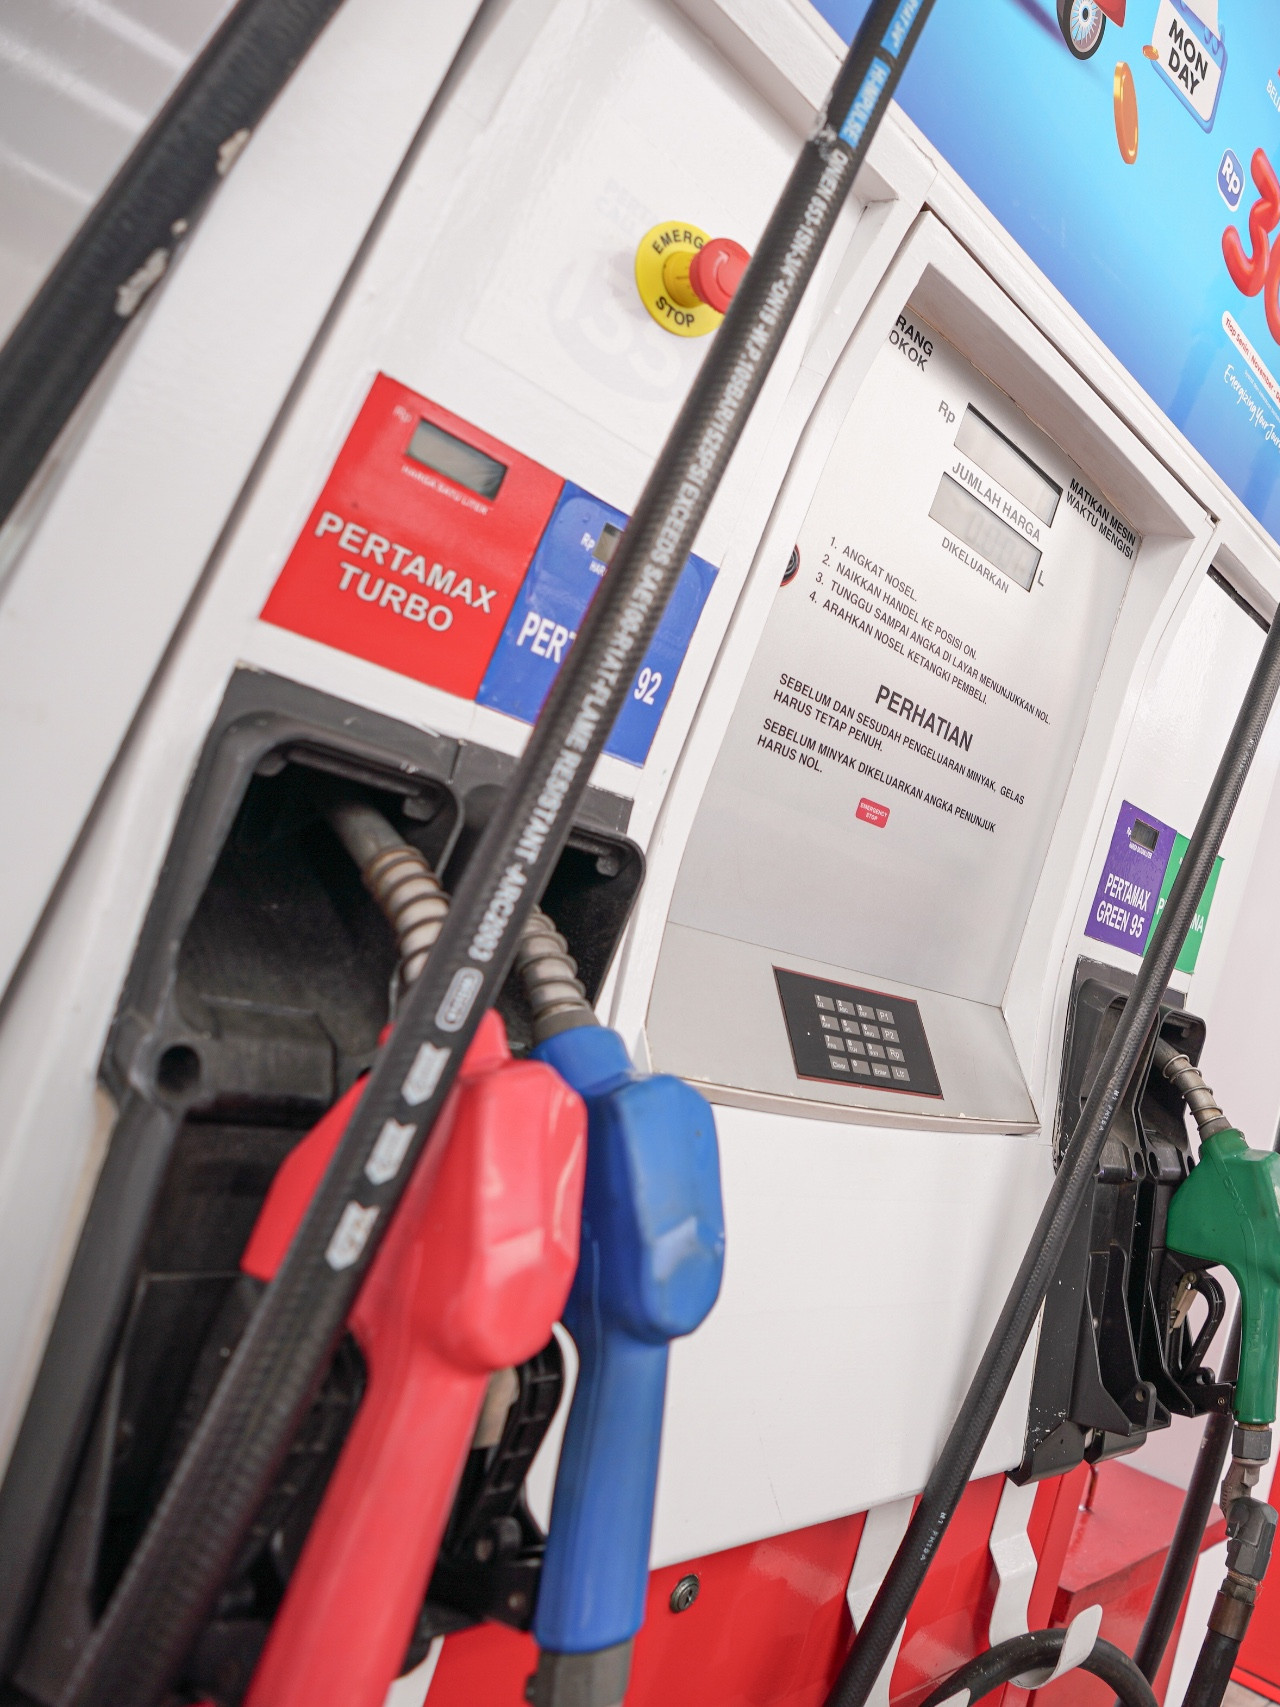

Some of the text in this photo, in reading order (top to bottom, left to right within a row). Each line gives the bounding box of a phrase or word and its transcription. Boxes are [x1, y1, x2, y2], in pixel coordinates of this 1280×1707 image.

[1168, 18, 1208, 81] MON
[1168, 46, 1200, 96] DAY
[1221, 155, 1241, 196] Rp
[652, 229, 704, 255] EMERG
[656, 296, 695, 327] STOP
[895, 314, 934, 357] RANG
[889, 330, 928, 372] OKOK
[1225, 317, 1237, 336] Tiap
[1236, 332, 1249, 357] Senin
[1250, 355, 1274, 390] November
[938, 400, 955, 423] Rp
[1223, 364, 1257, 422] Energizing
[647, 481, 701, 566] EXCEEDS
[952, 462, 1041, 542] JUMLAH HARGA
[1066, 491, 1134, 560] WAKTU MENGISI
[1069, 478, 1136, 547] MATIKAN MESIN
[314, 511, 497, 614] PERTAMAX
[580, 532, 596, 552] Rp
[589, 561, 607, 577] HAR
[830, 536, 917, 602] 1. ANGKAT NOSEL.
[941, 536, 1010, 594] DIKELUARKAN
[338, 561, 454, 632] TURBO
[1037, 569, 1044, 587] L
[822, 554, 977, 660] 2. NAIKKAN HANDEL KE POSISI ON.
[516, 611, 578, 663] PER
[809, 591, 987, 705] 4. ARAHKAN NOSEL KETANGKI PEMBELI.
[815, 571, 1051, 726] 3. TUNGGU SAMPAI ANGKA DI LAYAR MENUNJUKKAN NOL.
[634, 667, 663, 705] 92
[773, 689, 883, 752] HARUS TETAP PENUH.
[779, 673, 1025, 805] SEBELUM DAN SESUDAH PENGELUARAN MINYAK, GELAS
[874, 684, 974, 752] PERHATIAN
[757, 734, 823, 773] HARUS NOL.
[763, 718, 997, 833] SEBELUM MINYAK DIKELUARKAN ANGKA PENUNJUK
[511, 746, 583, 865] RESISTANT
[860, 802, 888, 818] EMERGENCY
[865, 812, 879, 822] STOP
[1096, 900, 1129, 933] GREEN
[1129, 913, 1146, 939] 95
[1104, 873, 1152, 912] PERTAMAX
[880, 1011, 889, 1021] P1
[885, 1030, 894, 1039] P2
